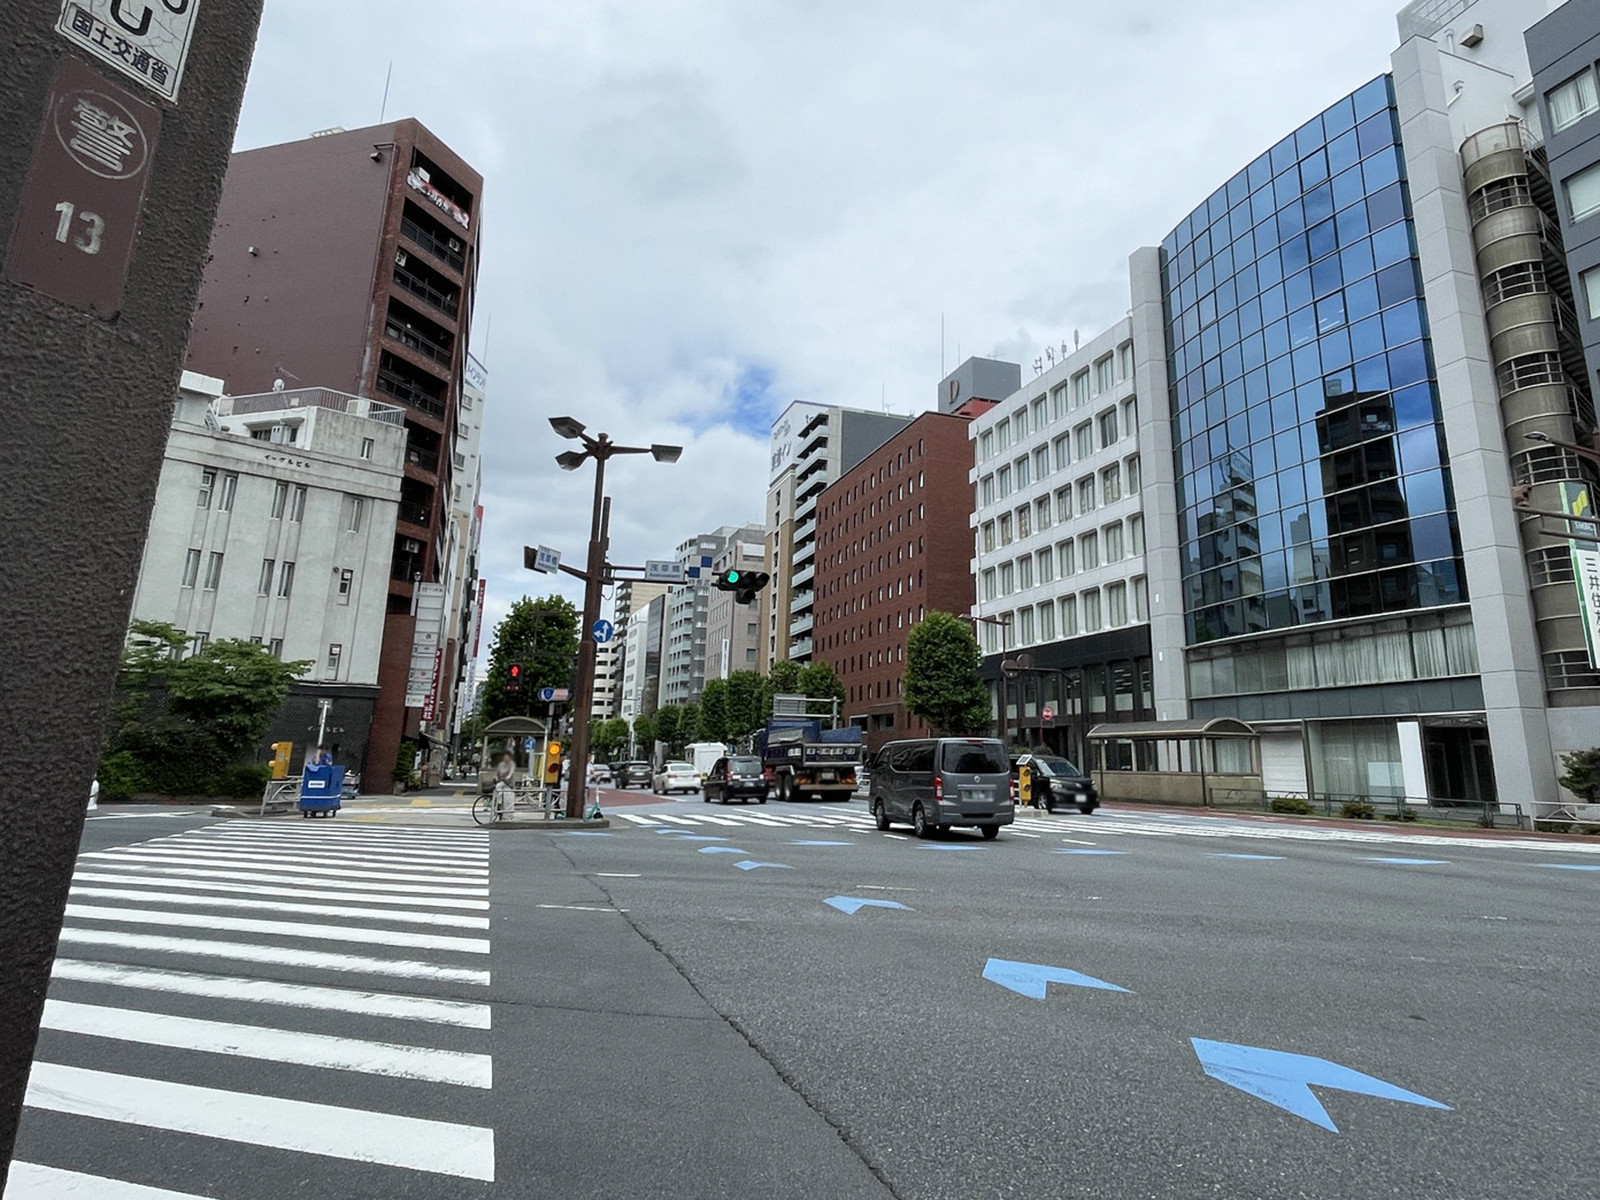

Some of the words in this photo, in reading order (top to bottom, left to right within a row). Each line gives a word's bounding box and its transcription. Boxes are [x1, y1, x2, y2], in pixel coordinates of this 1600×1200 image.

[72, 11, 170, 86] 国土交通省
[70, 98, 137, 172] 警
[55, 201, 105, 255] 13
[264, 454, 311, 469] イーグルビル
[307, 725, 345, 733] イールビル
